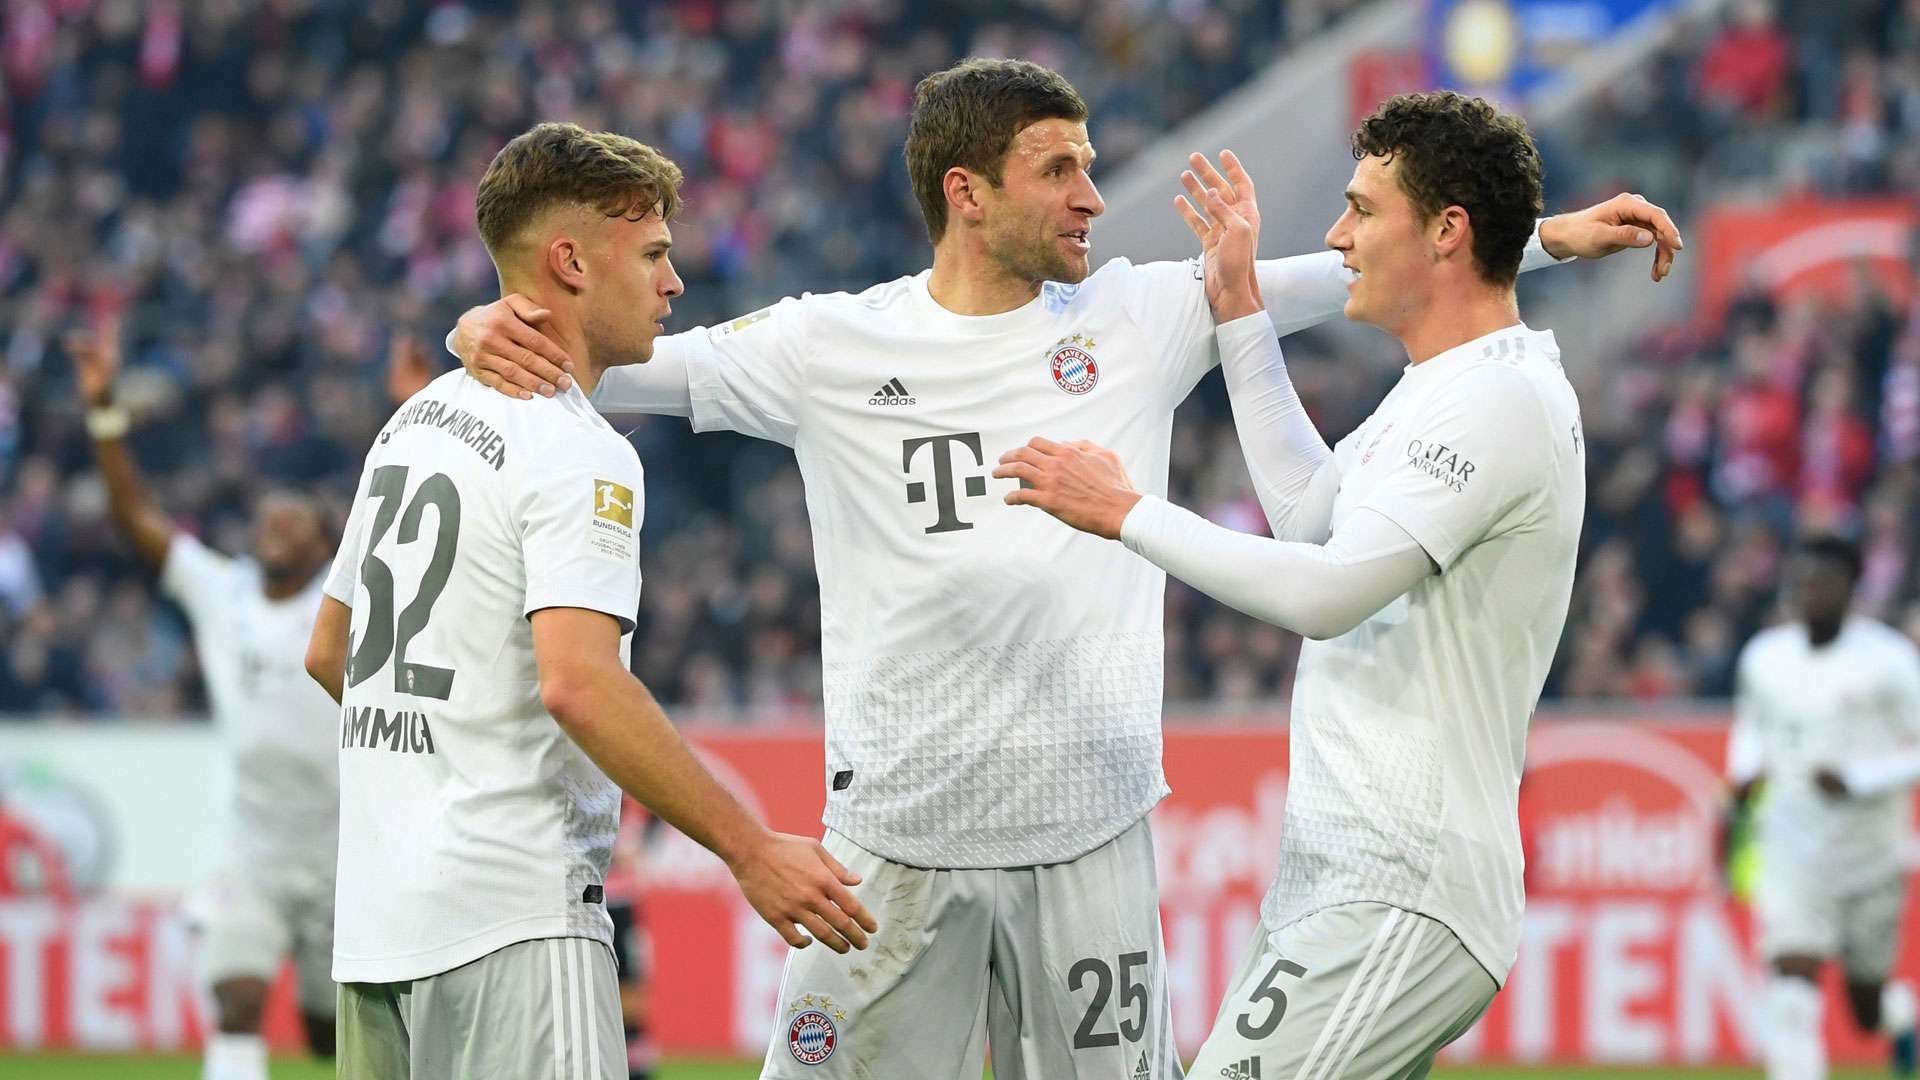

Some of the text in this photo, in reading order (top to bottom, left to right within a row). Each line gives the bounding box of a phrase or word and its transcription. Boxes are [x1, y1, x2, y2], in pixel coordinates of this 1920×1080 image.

[1058, 350, 1091, 367] BAYERN
[868, 395, 917, 406] adidas
[1408, 456, 1465, 494] AIRWAYS
[592, 519, 632, 538] BUNDESLIGA
[346, 464, 461, 701] 32
[1068, 950, 1149, 1050] 25
[1236, 958, 1308, 1041] 5
[803, 1014, 833, 1038] BAYERN
